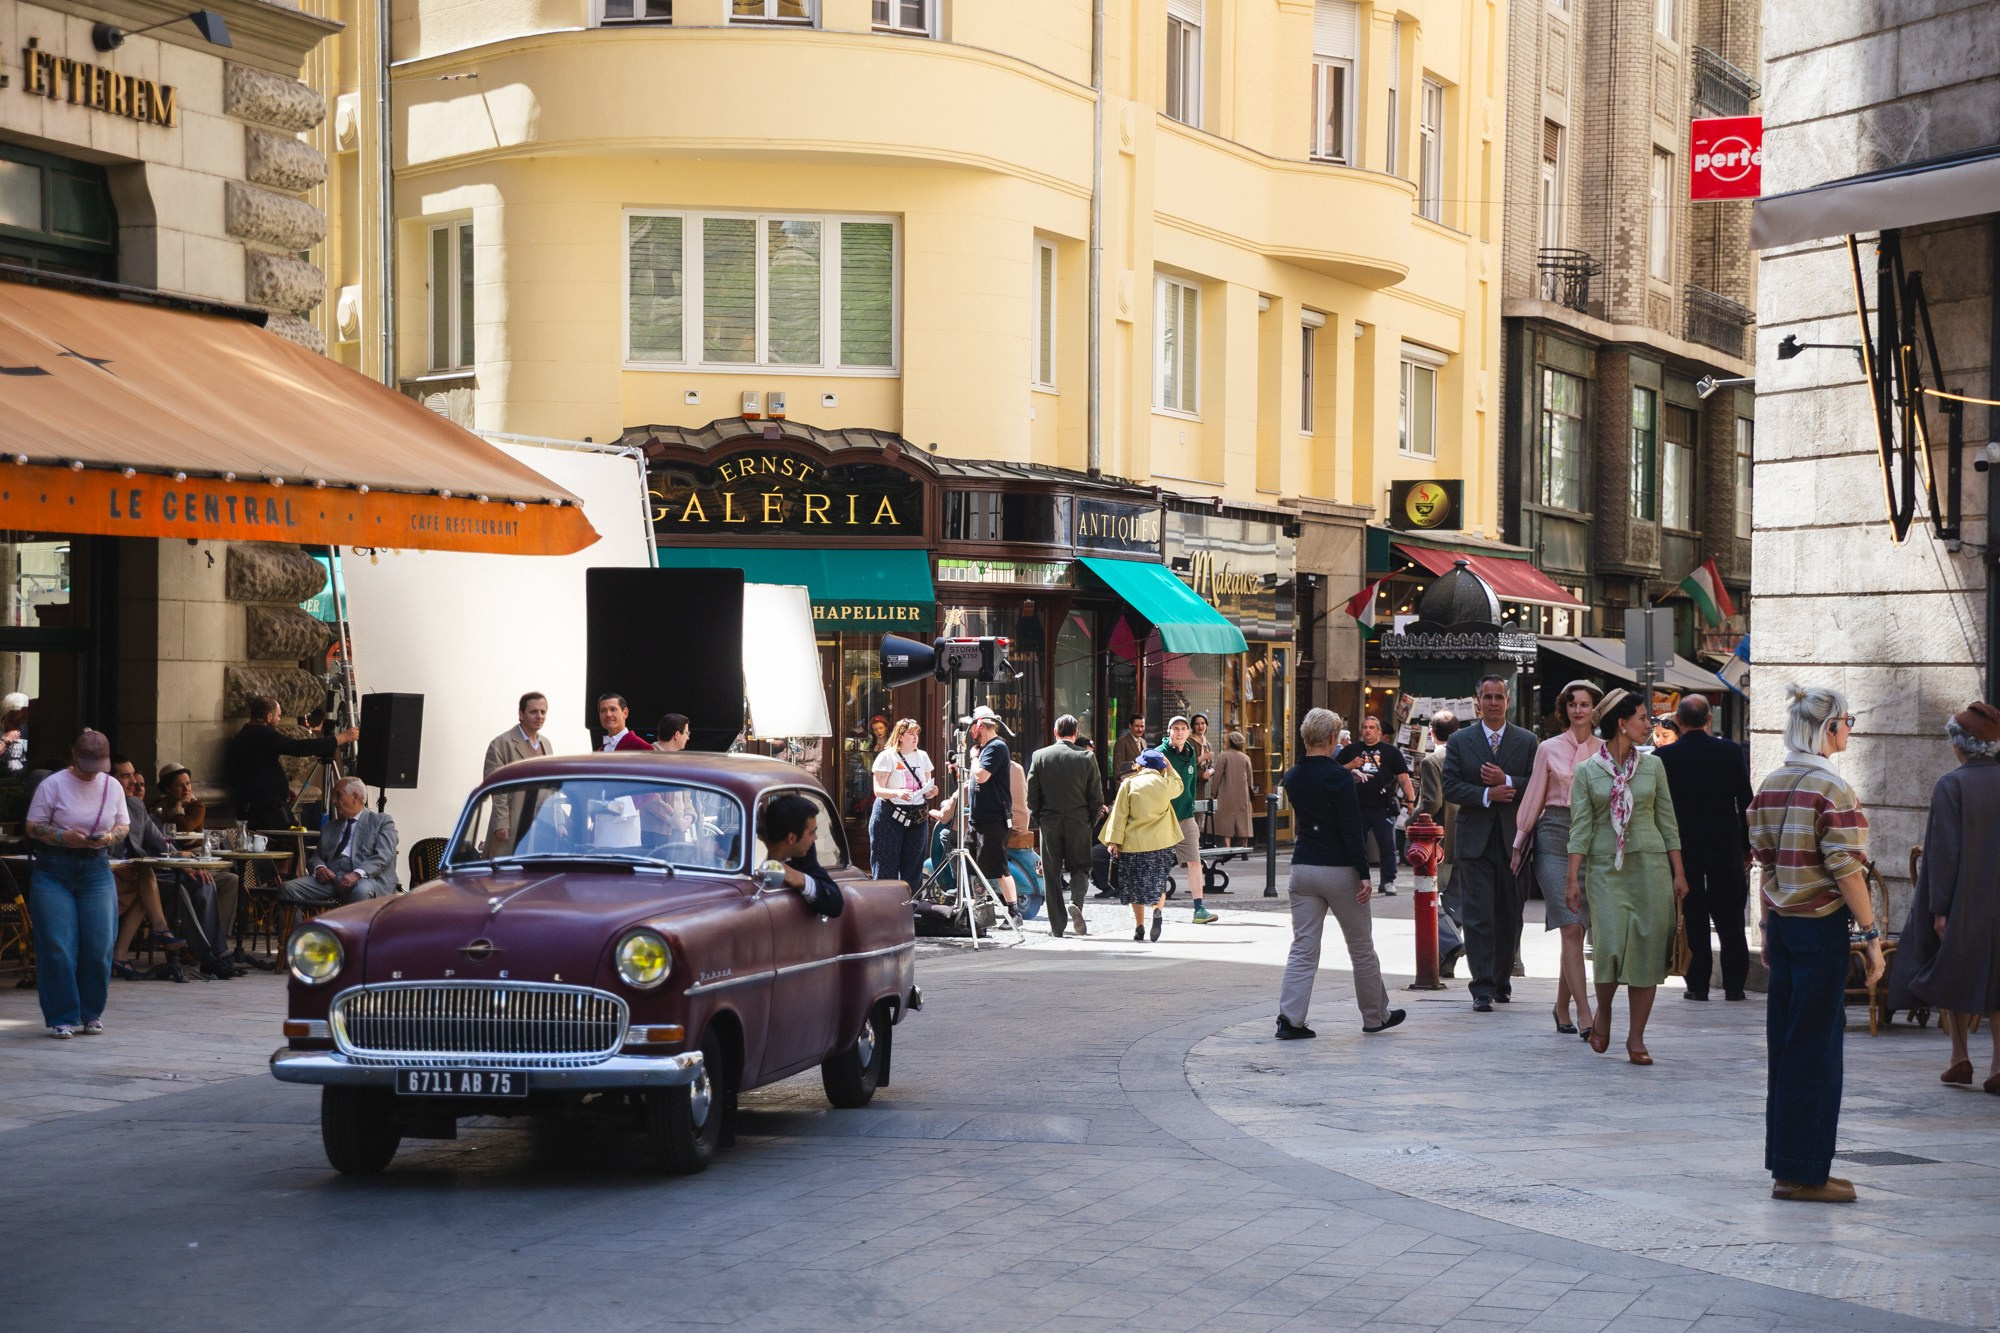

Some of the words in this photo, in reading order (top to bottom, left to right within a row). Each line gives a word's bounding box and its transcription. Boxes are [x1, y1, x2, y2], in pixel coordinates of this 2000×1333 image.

[23, 37, 178, 128] ÉTTEREM
[718, 456, 814, 483] ERNST
[110, 488, 142, 519] LE
[162, 490, 296, 527] CENTRAL
[643, 486, 901, 525] GALÉRIA
[411, 512, 439, 532] CAFÉ
[445, 516, 518, 536] RESTAURANT
[1079, 512, 1158, 546] ANTIQUES
[949, 646, 979, 654] STORM
[408, 1071, 453, 1092] 6711
[460, 1073, 482, 1093] AB
[490, 1073, 511, 1093] 75
